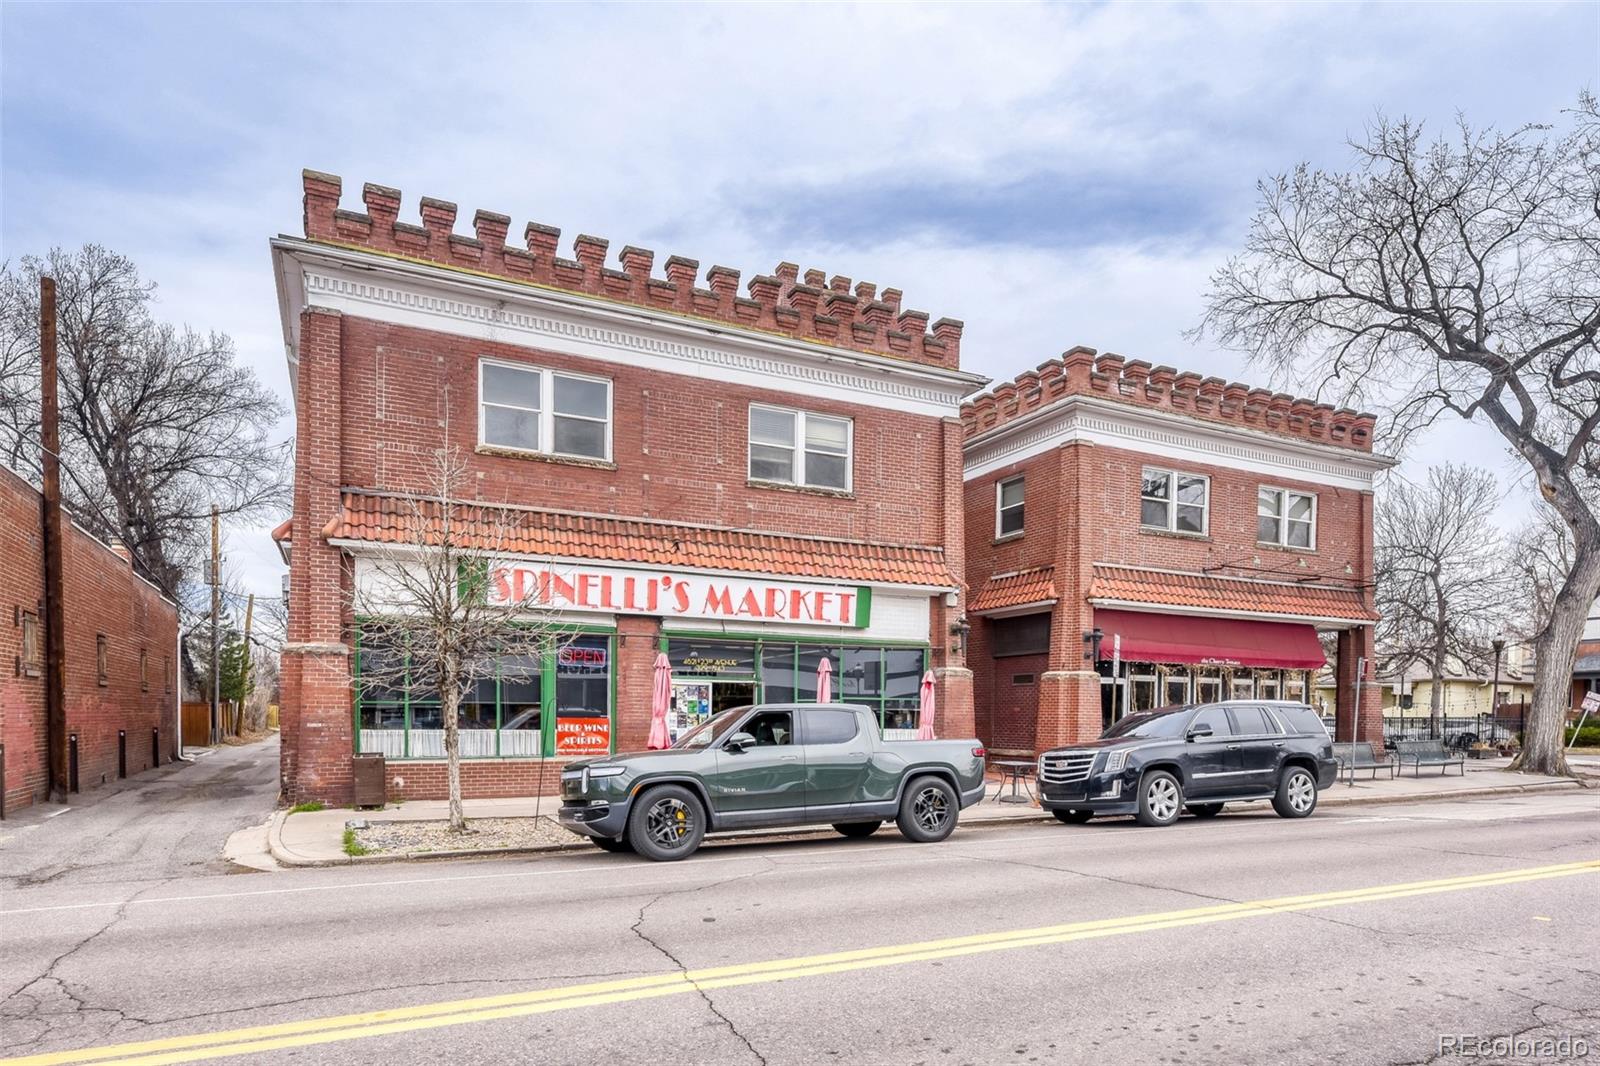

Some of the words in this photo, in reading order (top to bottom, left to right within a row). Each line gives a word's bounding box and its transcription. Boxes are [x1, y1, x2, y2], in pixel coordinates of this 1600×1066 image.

[492, 567, 690, 613] SPINELLI'S
[702, 584, 856, 624] MARKET
[561, 649, 603, 665] OPEN
[557, 723, 584, 733] BEER
[584, 723, 609, 733] WINE
[563, 736, 603, 745] SPIRITS
